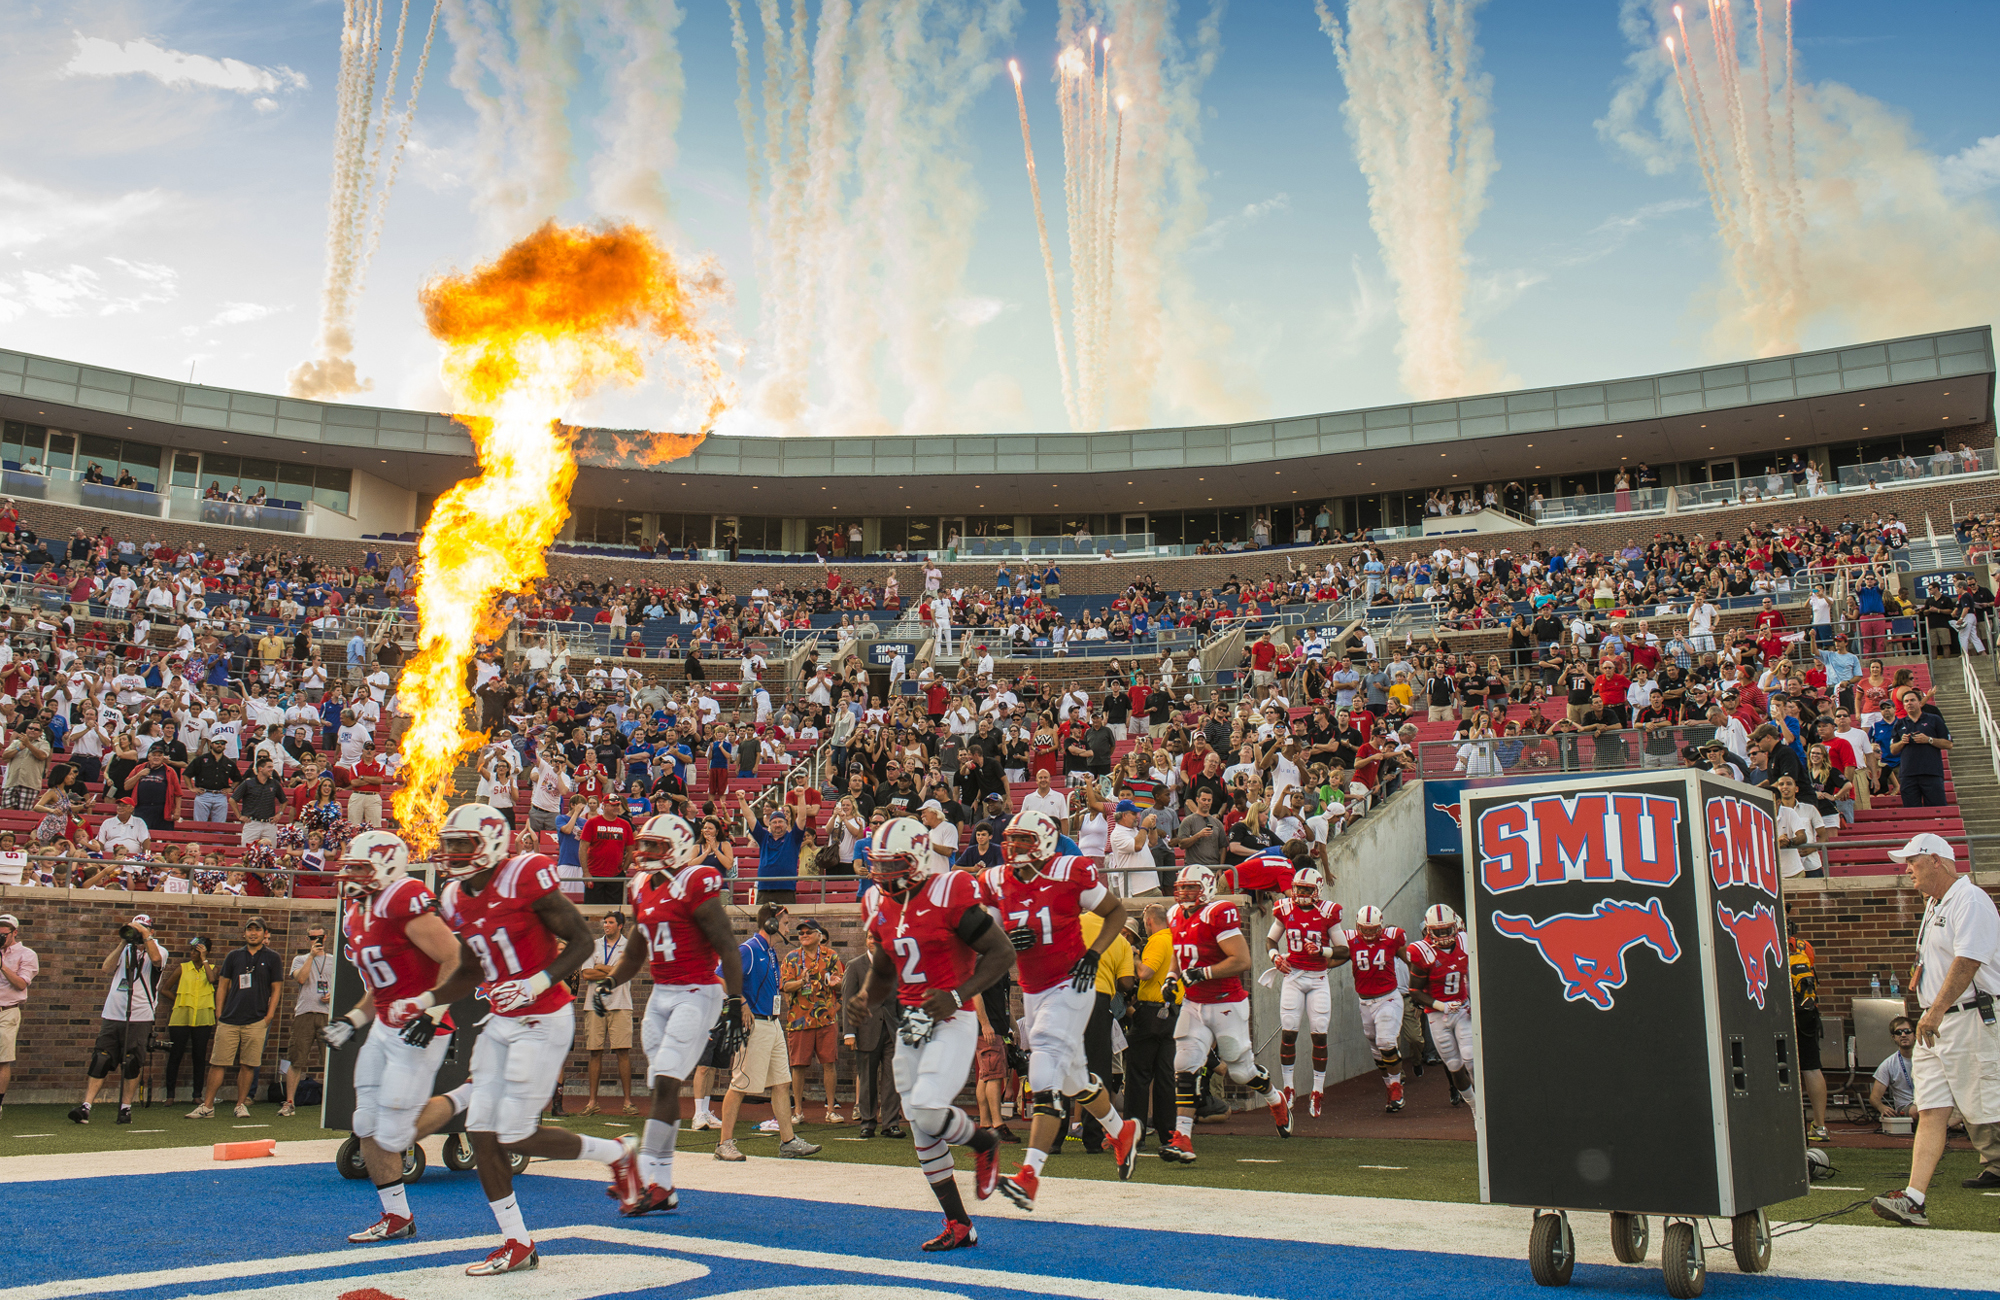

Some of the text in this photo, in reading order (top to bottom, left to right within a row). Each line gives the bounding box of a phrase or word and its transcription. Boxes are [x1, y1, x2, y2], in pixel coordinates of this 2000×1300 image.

[1921, 573, 1967, 586] 212-2
[1303, 627, 1338, 638] 2-212
[875, 645, 908, 653] 210211
[1572, 679, 1586, 690] 16
[586, 777, 596, 791] 8
[1478, 792, 1681, 895] SMU
[1706, 796, 1779, 899] SMU
[1224, 908, 1239, 924] 72
[353, 945, 398, 989] 6
[893, 936, 928, 984] 2
[1356, 949, 1386, 971] 64
[1444, 971, 1461, 995] 9
